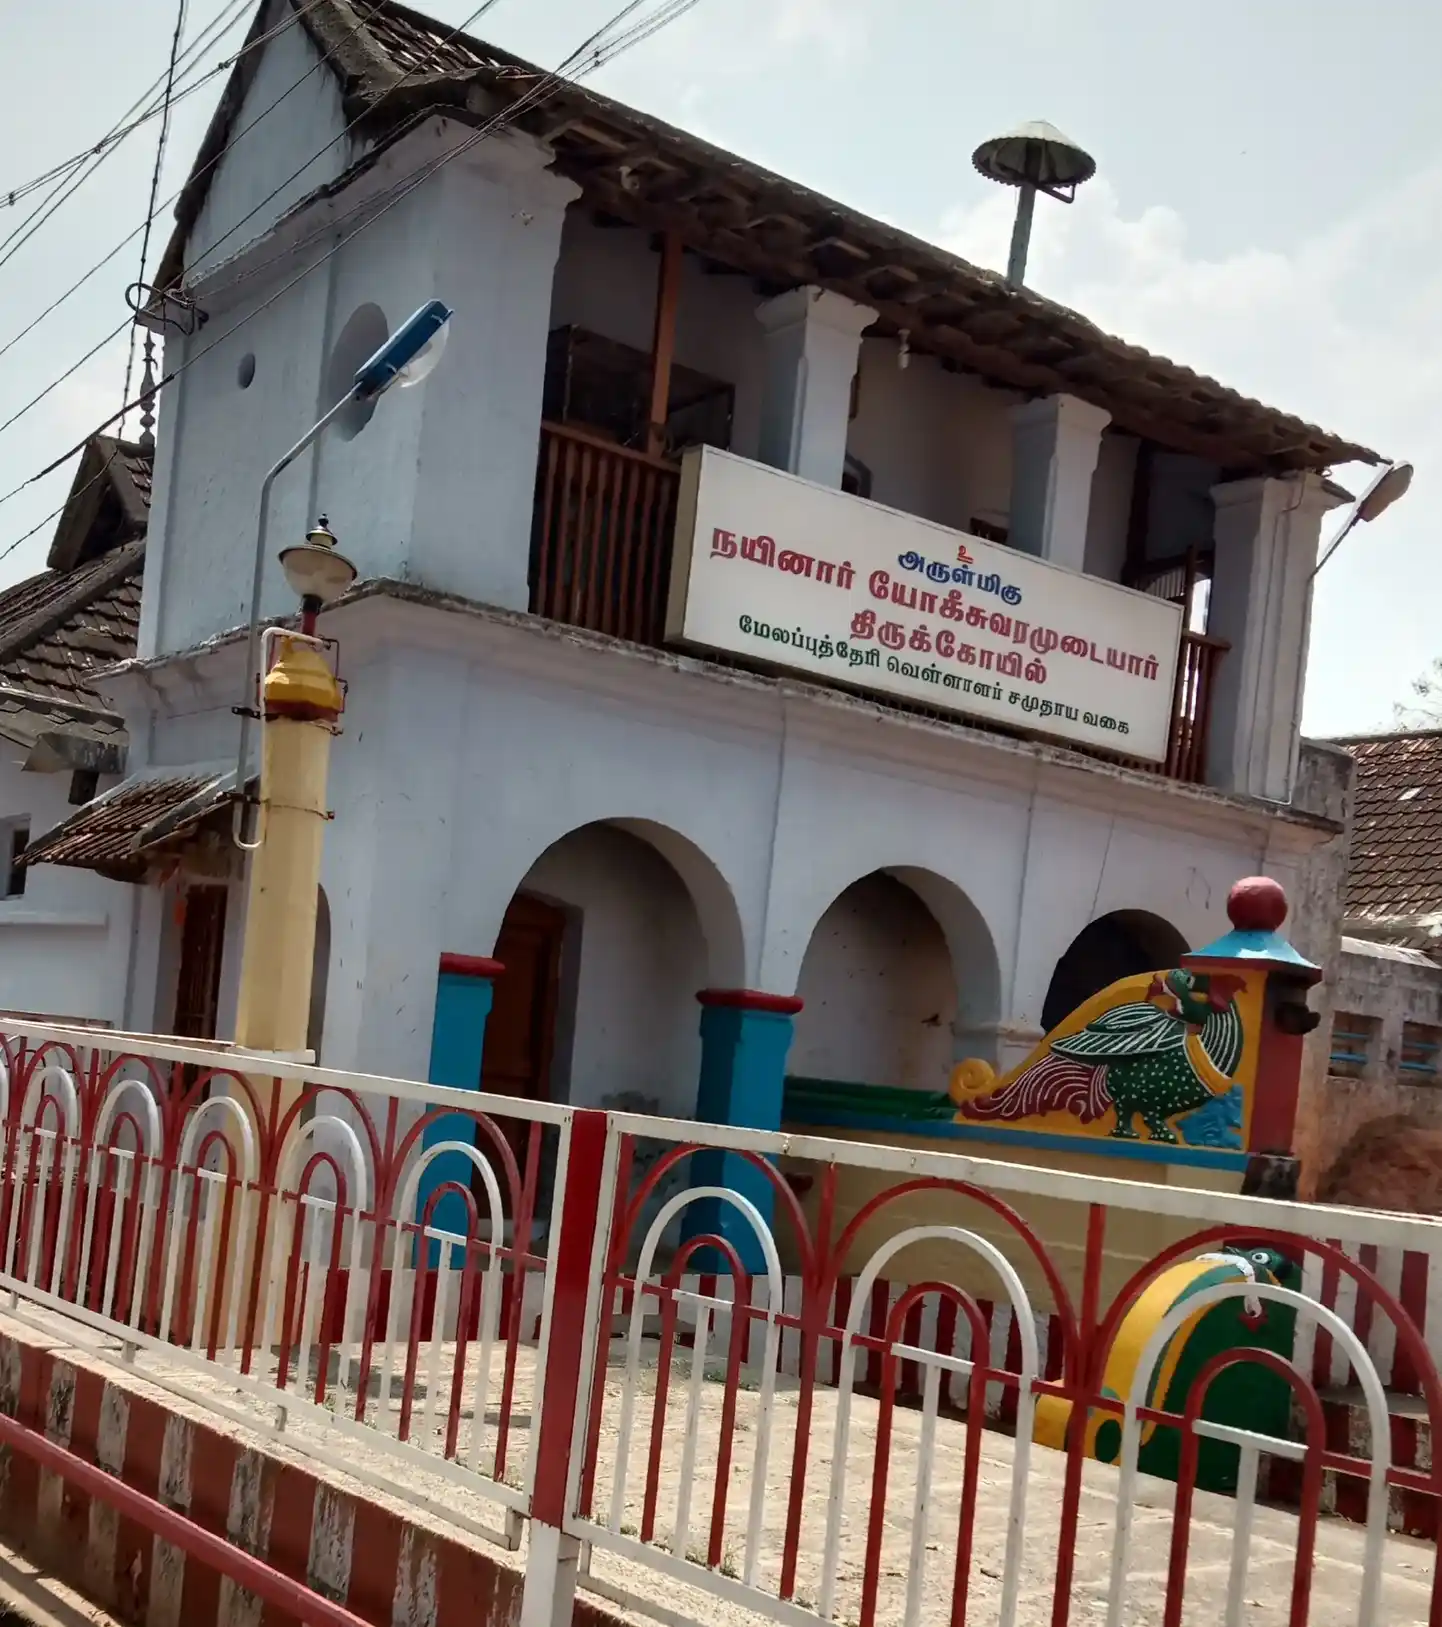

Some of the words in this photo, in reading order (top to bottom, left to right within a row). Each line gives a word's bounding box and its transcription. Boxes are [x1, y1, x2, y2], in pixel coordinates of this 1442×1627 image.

[710, 527, 856, 590] நயினார்
[868, 569, 1160, 681] யோகீசுவரமுடையார்
[898, 551, 1023, 606] அருள்மிகு
[739, 614, 880, 668] மேலப்புத்தேரி
[1008, 690, 1079, 721] சமுதாய
[1083, 711, 1130, 735] வகை
[850, 608, 1047, 684] திருக்கோயில்
